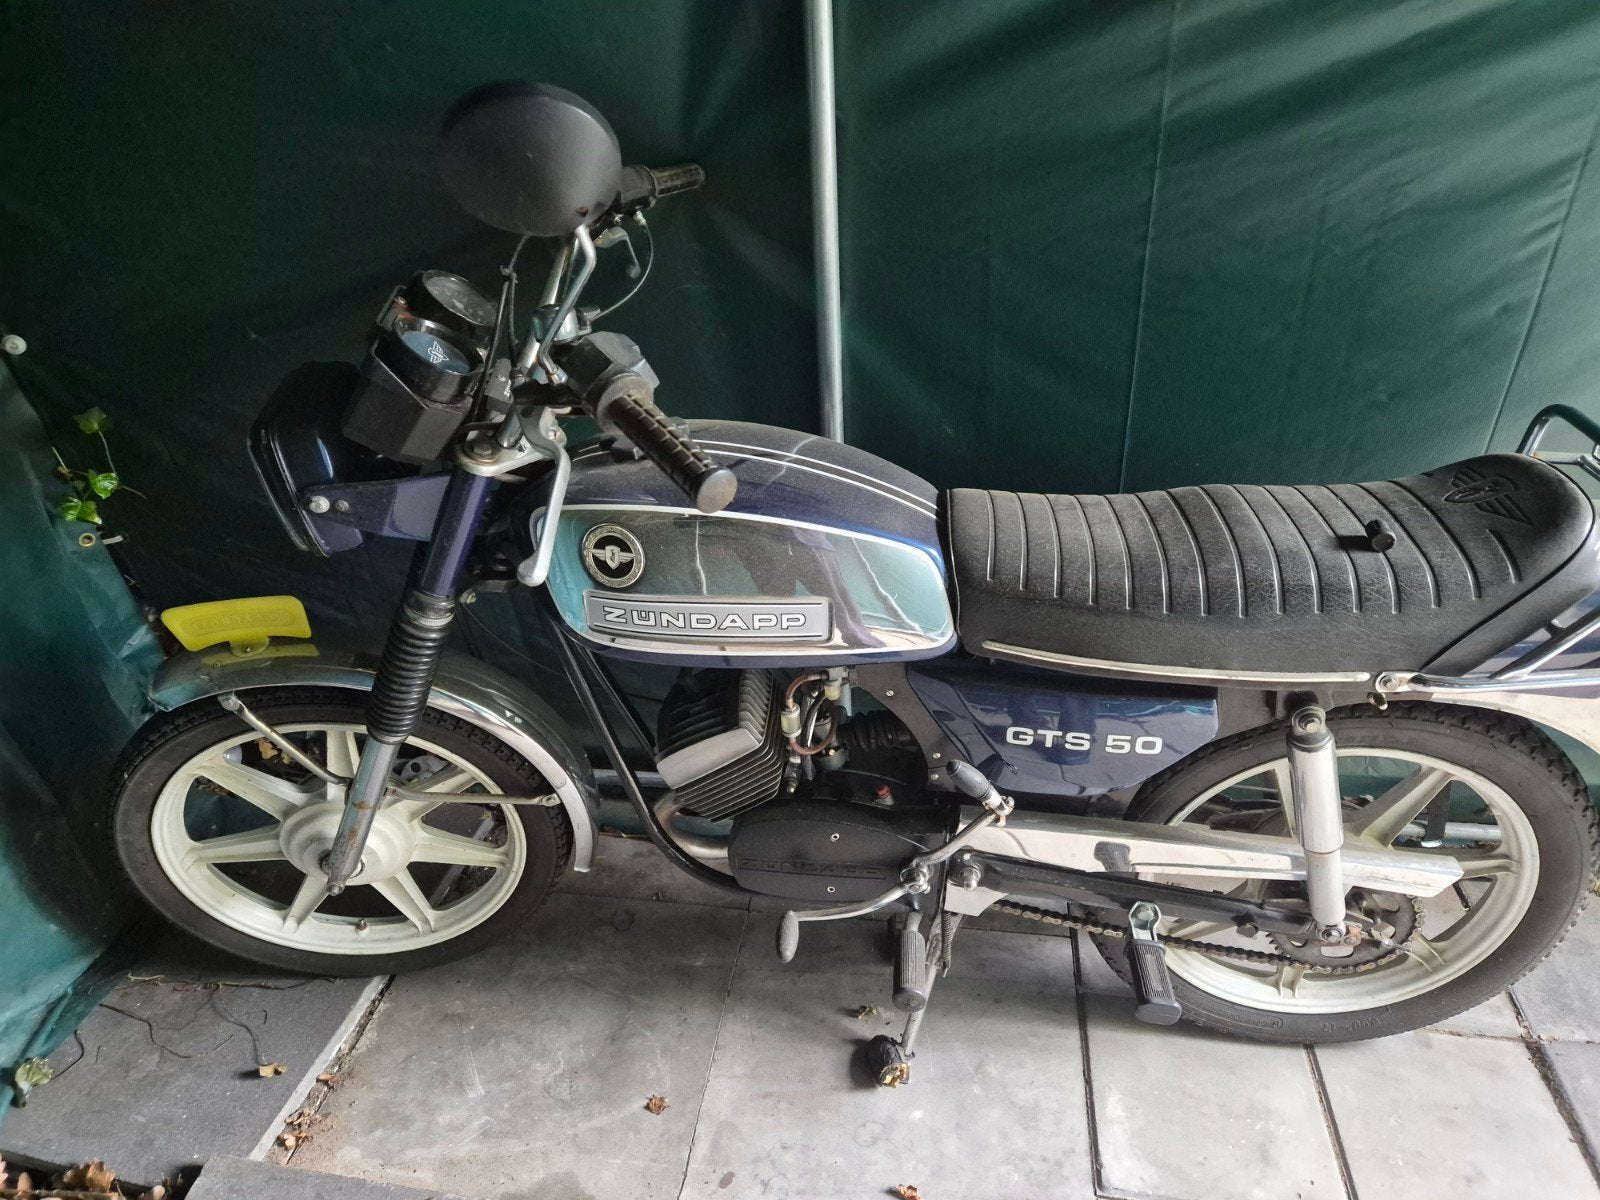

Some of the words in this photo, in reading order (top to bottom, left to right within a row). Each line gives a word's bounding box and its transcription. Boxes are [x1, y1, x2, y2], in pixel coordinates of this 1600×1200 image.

[602, 605, 807, 630] ZÜNDAPP
[1006, 726, 1091, 751] GTS
[1105, 734, 1163, 755] 50
